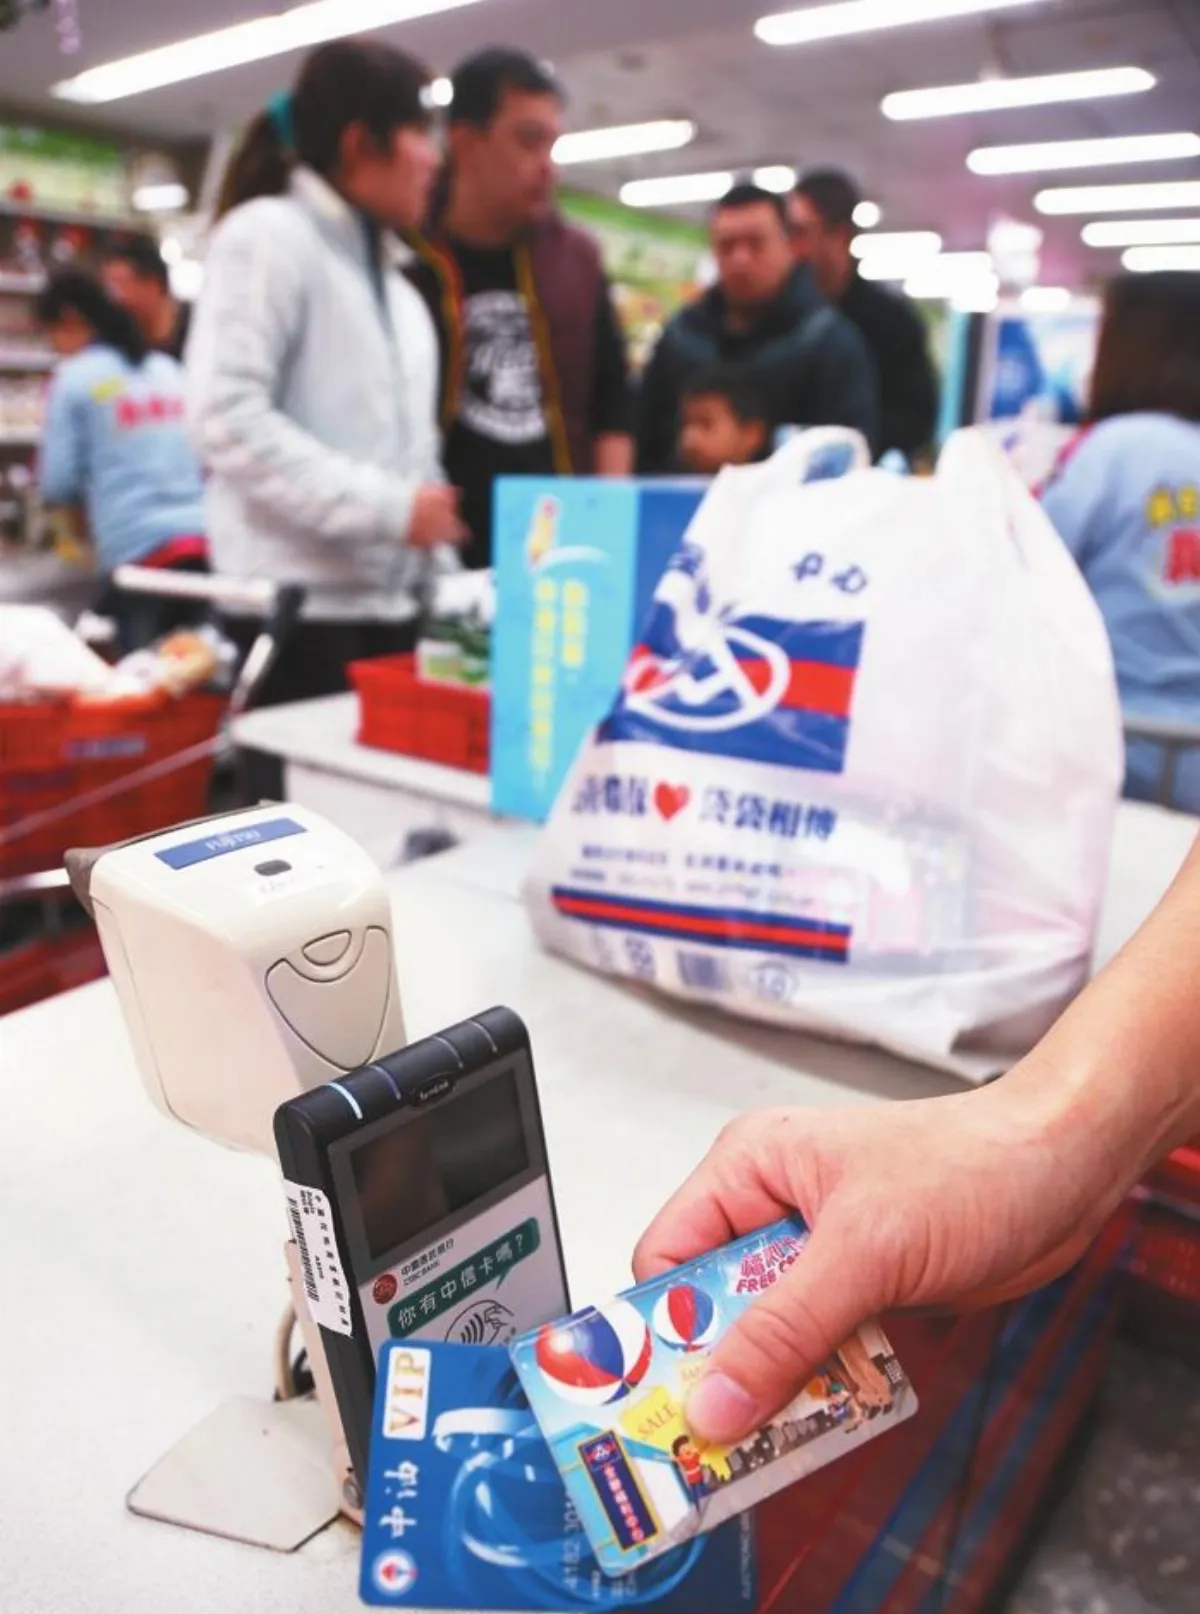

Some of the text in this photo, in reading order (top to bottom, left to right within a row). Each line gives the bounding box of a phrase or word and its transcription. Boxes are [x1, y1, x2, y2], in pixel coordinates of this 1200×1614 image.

[791, 552, 868, 594] 中心
[736, 1270, 777, 1293] FREE
[389, 1352, 425, 1433] VIP
[379, 1460, 420, 1538] 中油
